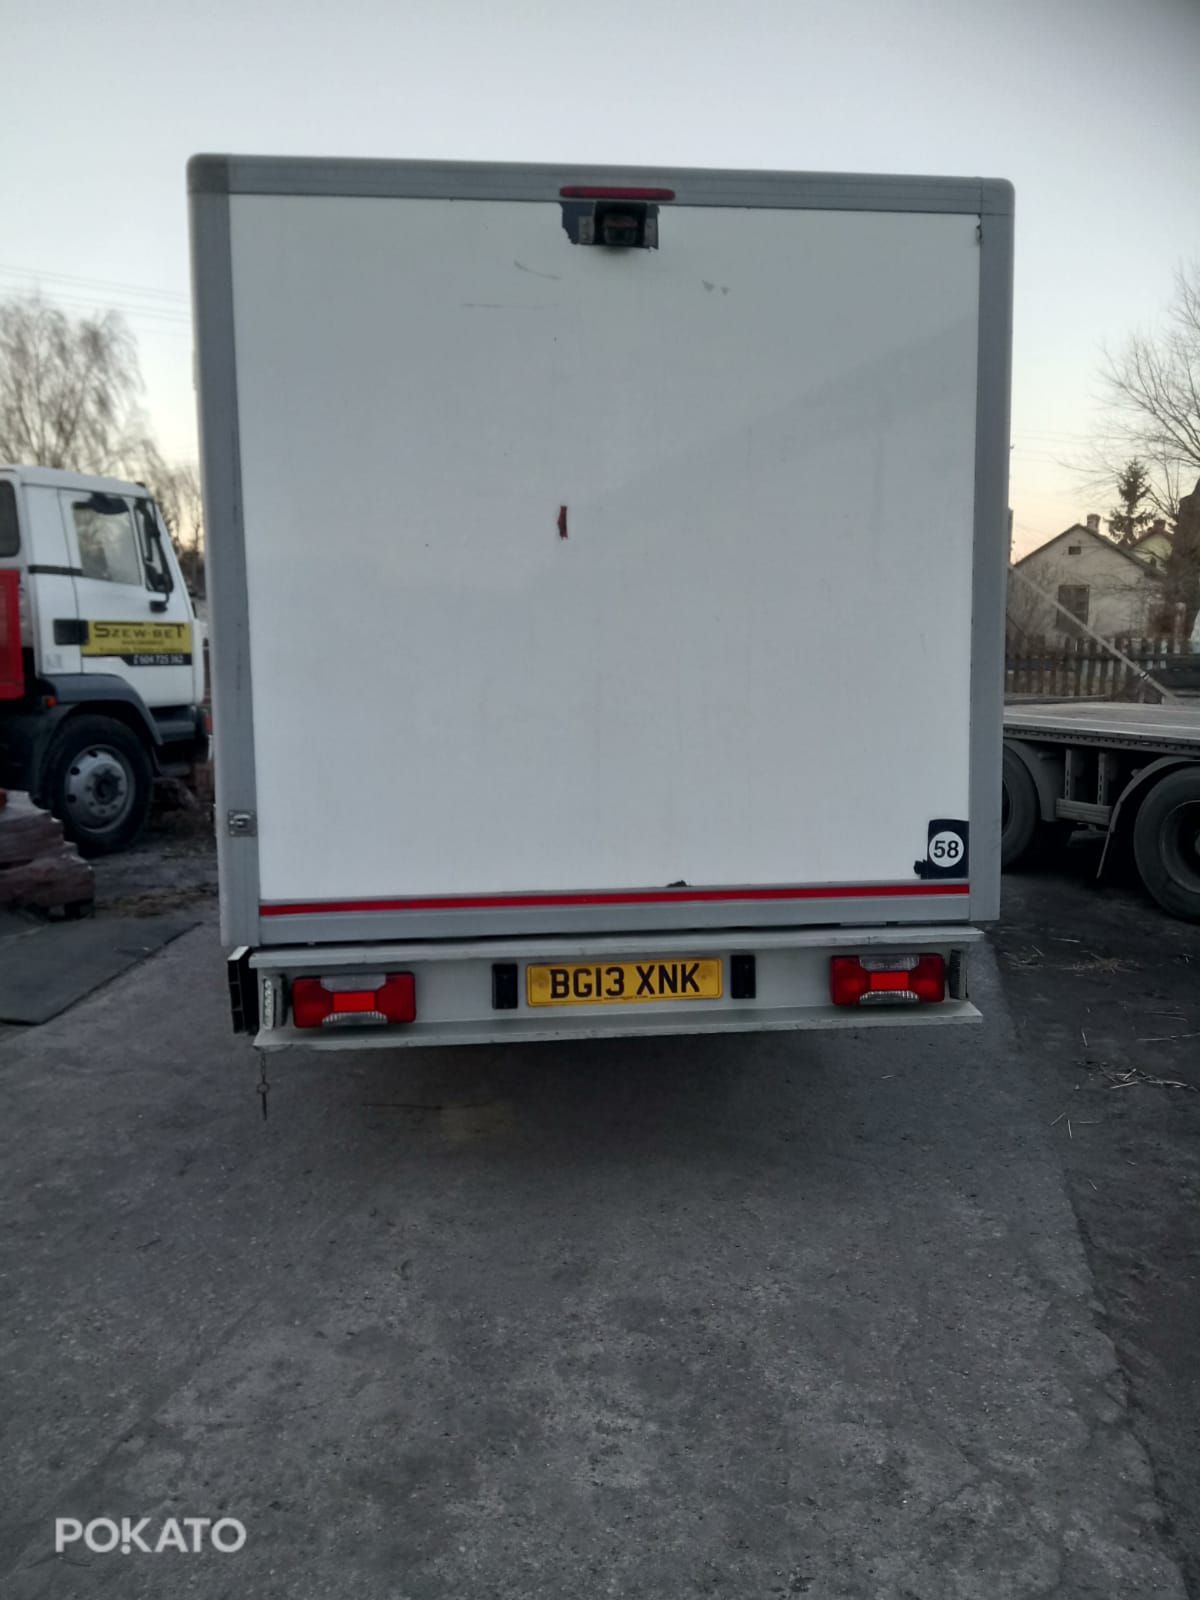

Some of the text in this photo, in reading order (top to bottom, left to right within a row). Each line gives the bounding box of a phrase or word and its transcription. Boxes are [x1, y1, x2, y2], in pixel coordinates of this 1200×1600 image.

[933, 840, 959, 858] 58
[550, 963, 700, 999] BG13 XNK
